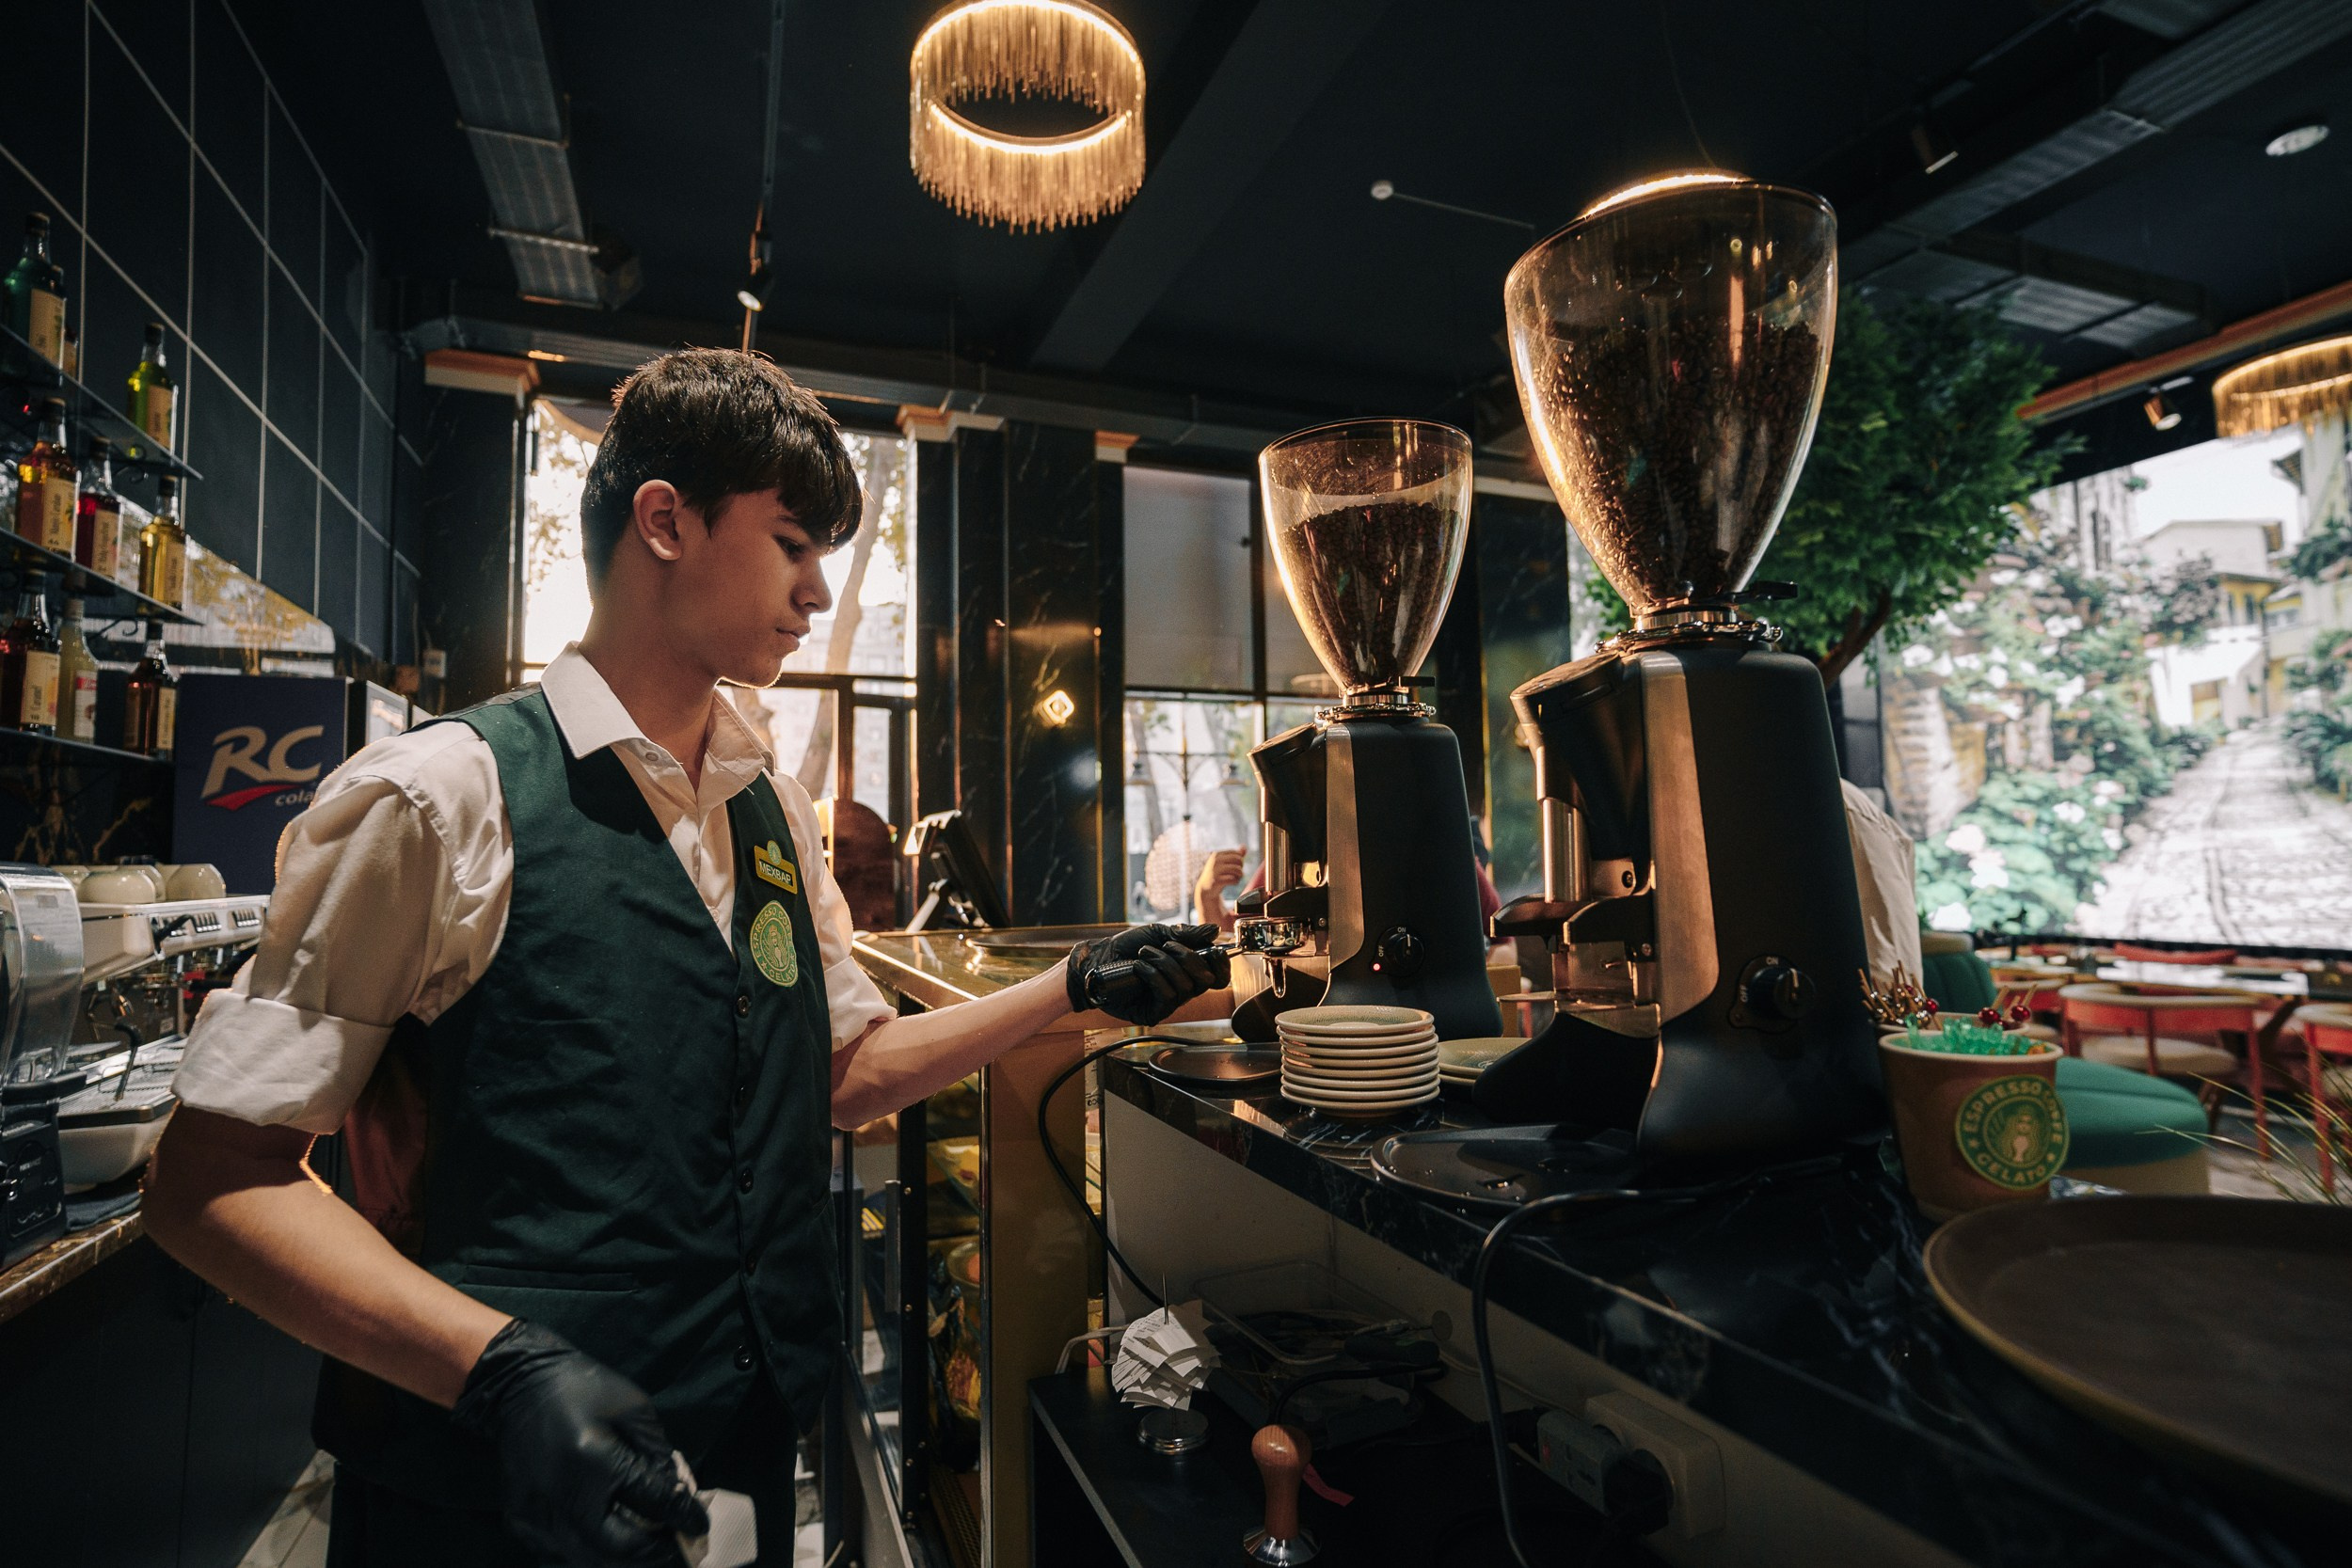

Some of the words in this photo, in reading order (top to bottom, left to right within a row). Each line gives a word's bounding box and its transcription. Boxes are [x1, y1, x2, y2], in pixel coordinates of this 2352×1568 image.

[201, 725, 324, 799] RC
[275, 790, 314, 807] cola
[753, 908, 777, 958] ESPRESSO
[770, 963, 796, 982] GELATO
[1766, 957, 1779, 966] ON
[1740, 984, 1748, 1003] OFF
[1963, 1082, 2042, 1132] ESPRESSO
[1978, 1153, 2046, 1183] GELATO
